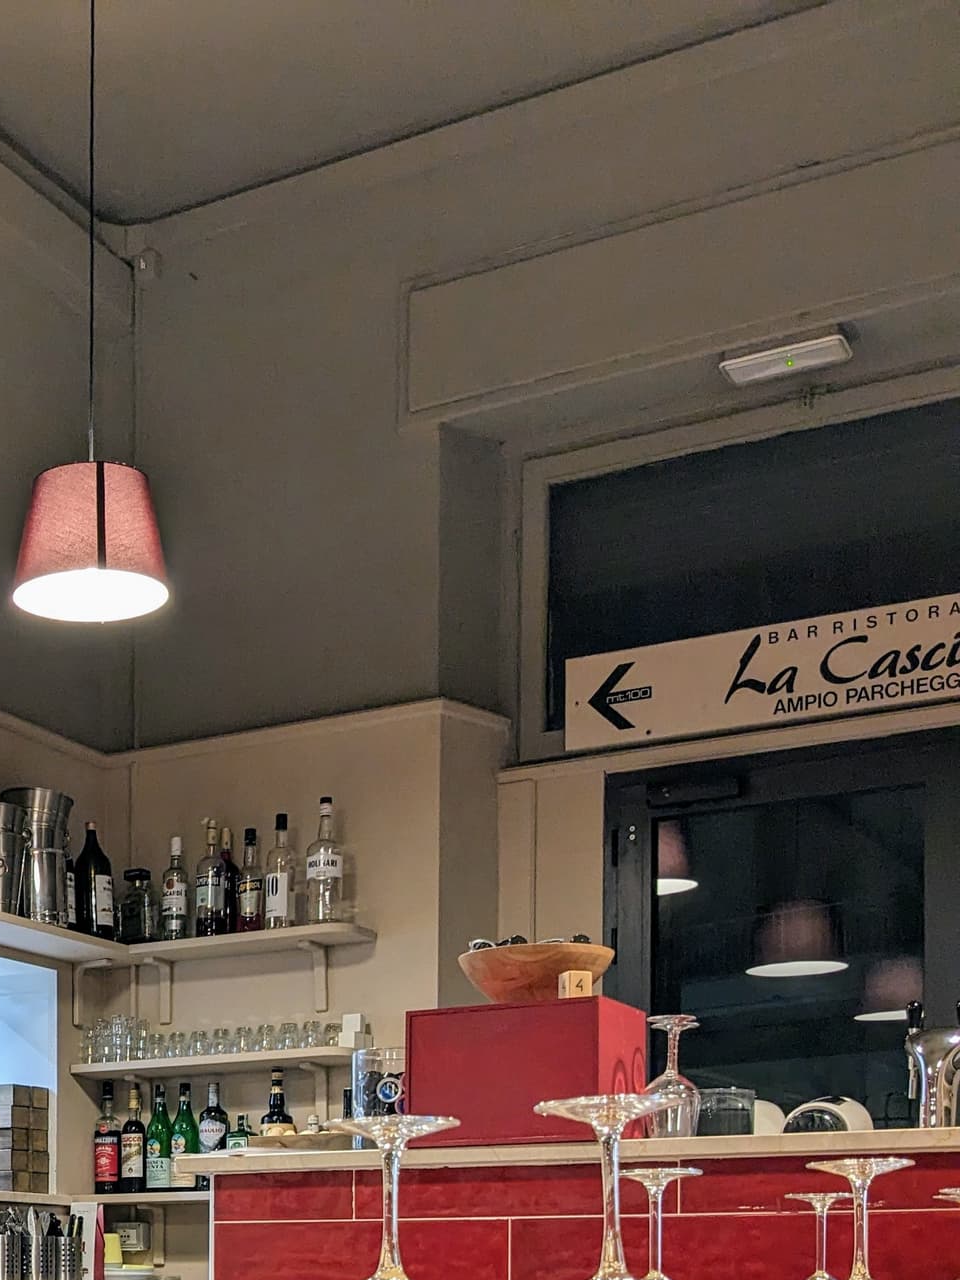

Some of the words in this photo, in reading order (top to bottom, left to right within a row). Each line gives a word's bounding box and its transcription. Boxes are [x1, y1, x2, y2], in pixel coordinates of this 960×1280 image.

[767, 625, 818, 645] BAR
[832, 602, 960, 634] RISTORA
[723, 633, 798, 704] La
[605, 687, 651, 704] mt.100
[772, 690, 839, 715] AMPIO
[845, 672, 960, 705] PARCHEGG
[575, 978, 583, 992] 4
